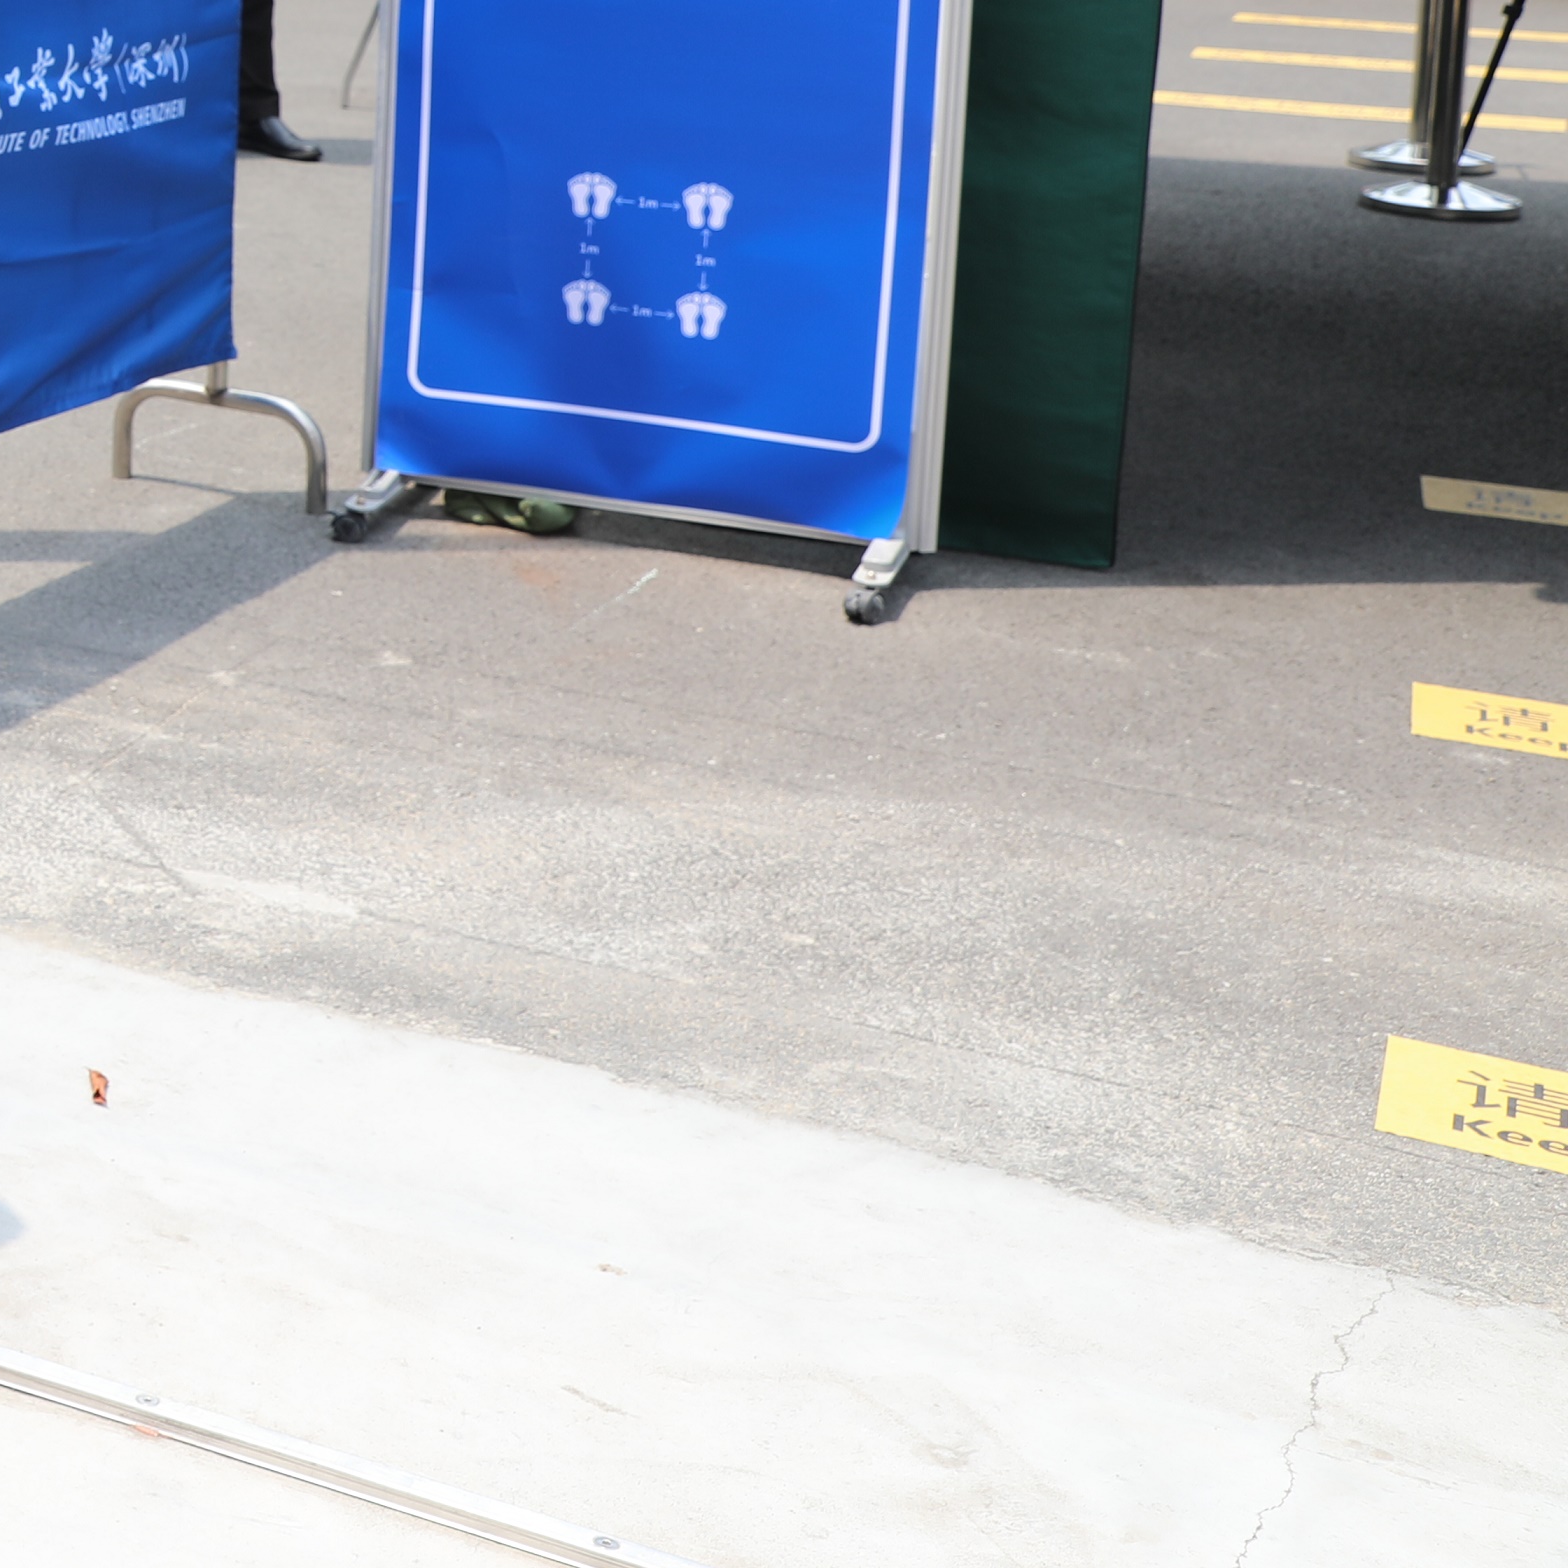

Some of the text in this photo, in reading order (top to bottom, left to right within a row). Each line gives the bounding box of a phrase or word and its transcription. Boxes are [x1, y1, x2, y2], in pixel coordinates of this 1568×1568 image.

[29, 128, 51, 150] OF
[130, 97, 187, 130] SHENZHEN
[638, 196, 658, 209] 1m
[579, 242, 599, 255] 1m
[695, 254, 716, 267] 1m
[632, 304, 652, 317] 1m
